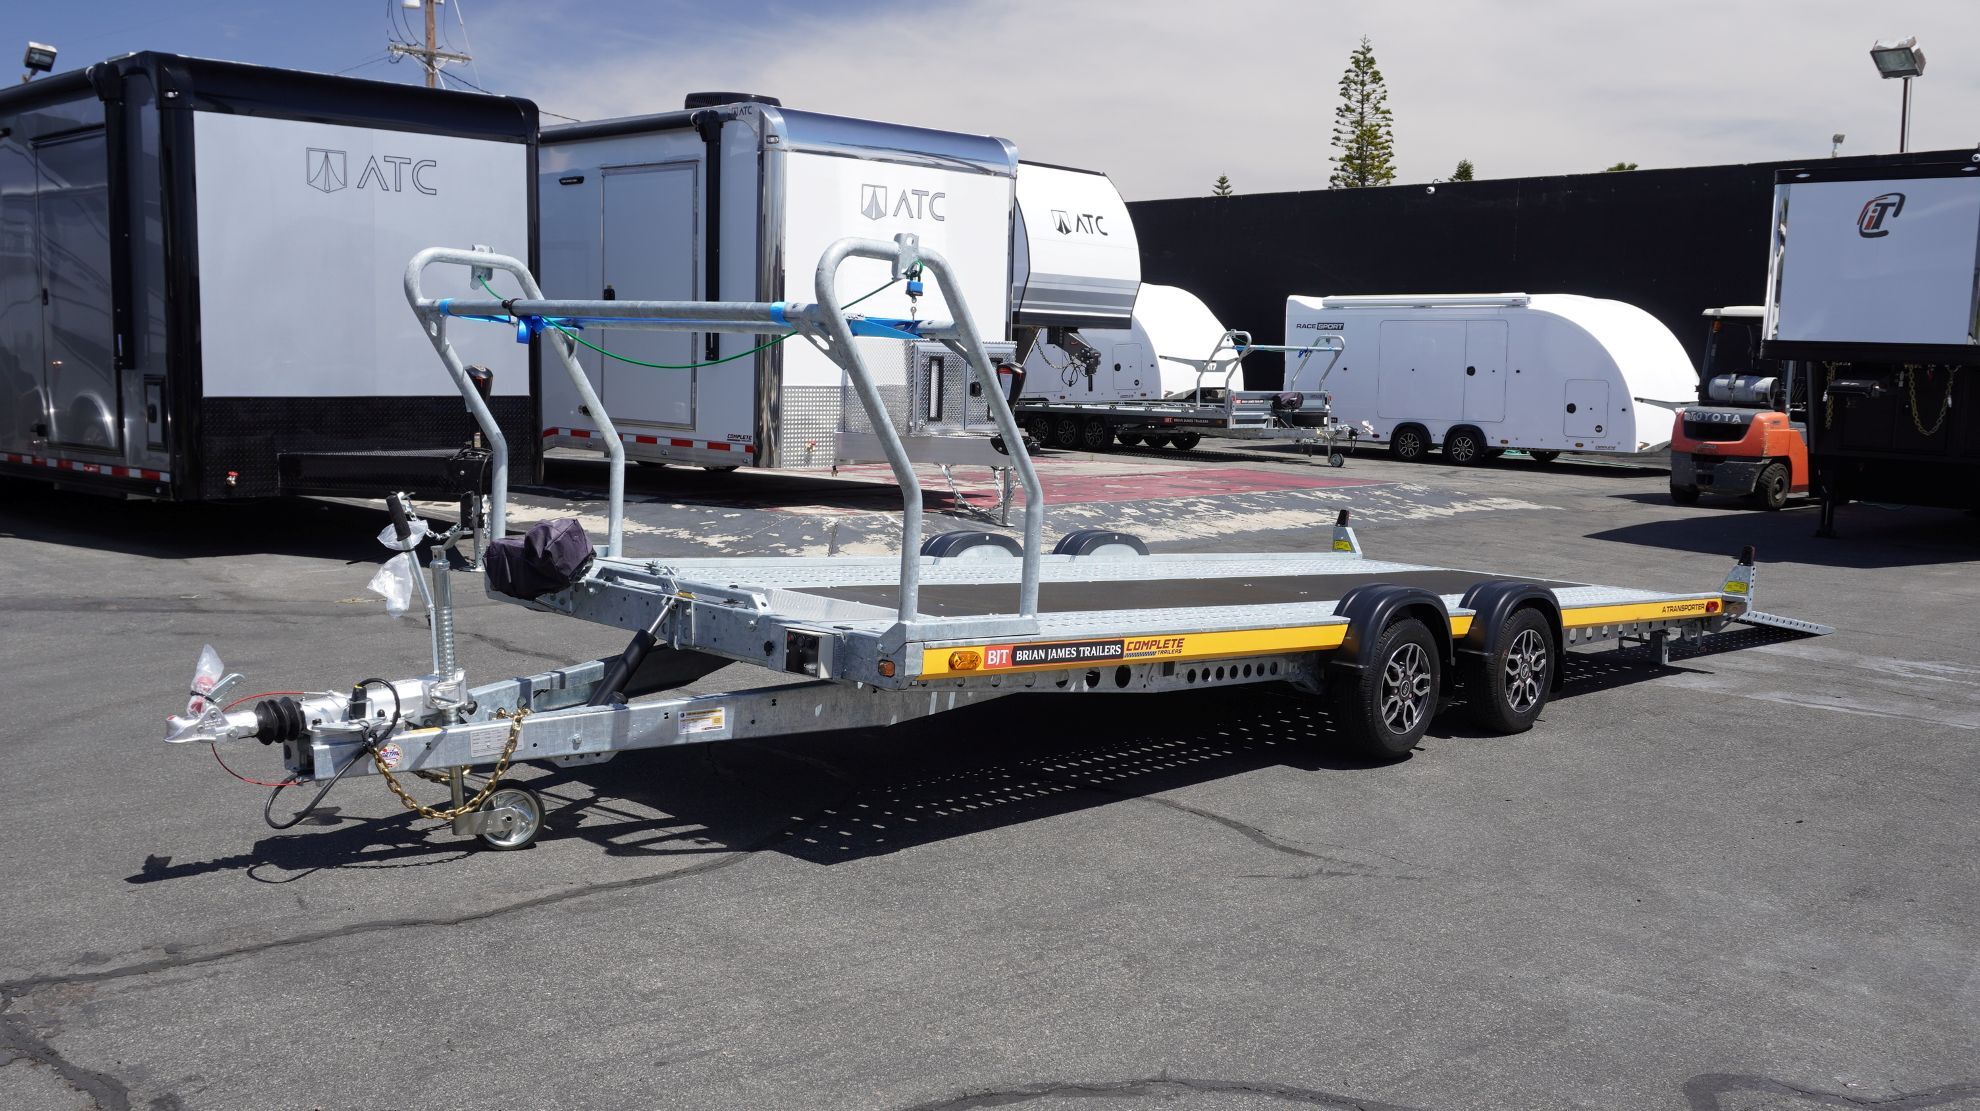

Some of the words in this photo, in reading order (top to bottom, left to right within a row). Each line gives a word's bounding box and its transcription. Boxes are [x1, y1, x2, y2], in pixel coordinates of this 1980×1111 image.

[739, 105, 753, 116] ATC
[356, 154, 437, 196] ATC
[892, 188, 946, 222] ATC
[1075, 213, 1108, 237] ATC
[1317, 322, 1344, 331] SPORT
[1689, 411, 1742, 423] TOYOTA
[1667, 603, 1705, 612] TRANSPORTER
[1126, 638, 1185, 652] COMPLETE
[987, 649, 1010, 665] BJT
[1016, 649, 1046, 661] BRIAN
[1047, 647, 1077, 661] JAMES
[1079, 644, 1122, 657] TRAILERS
